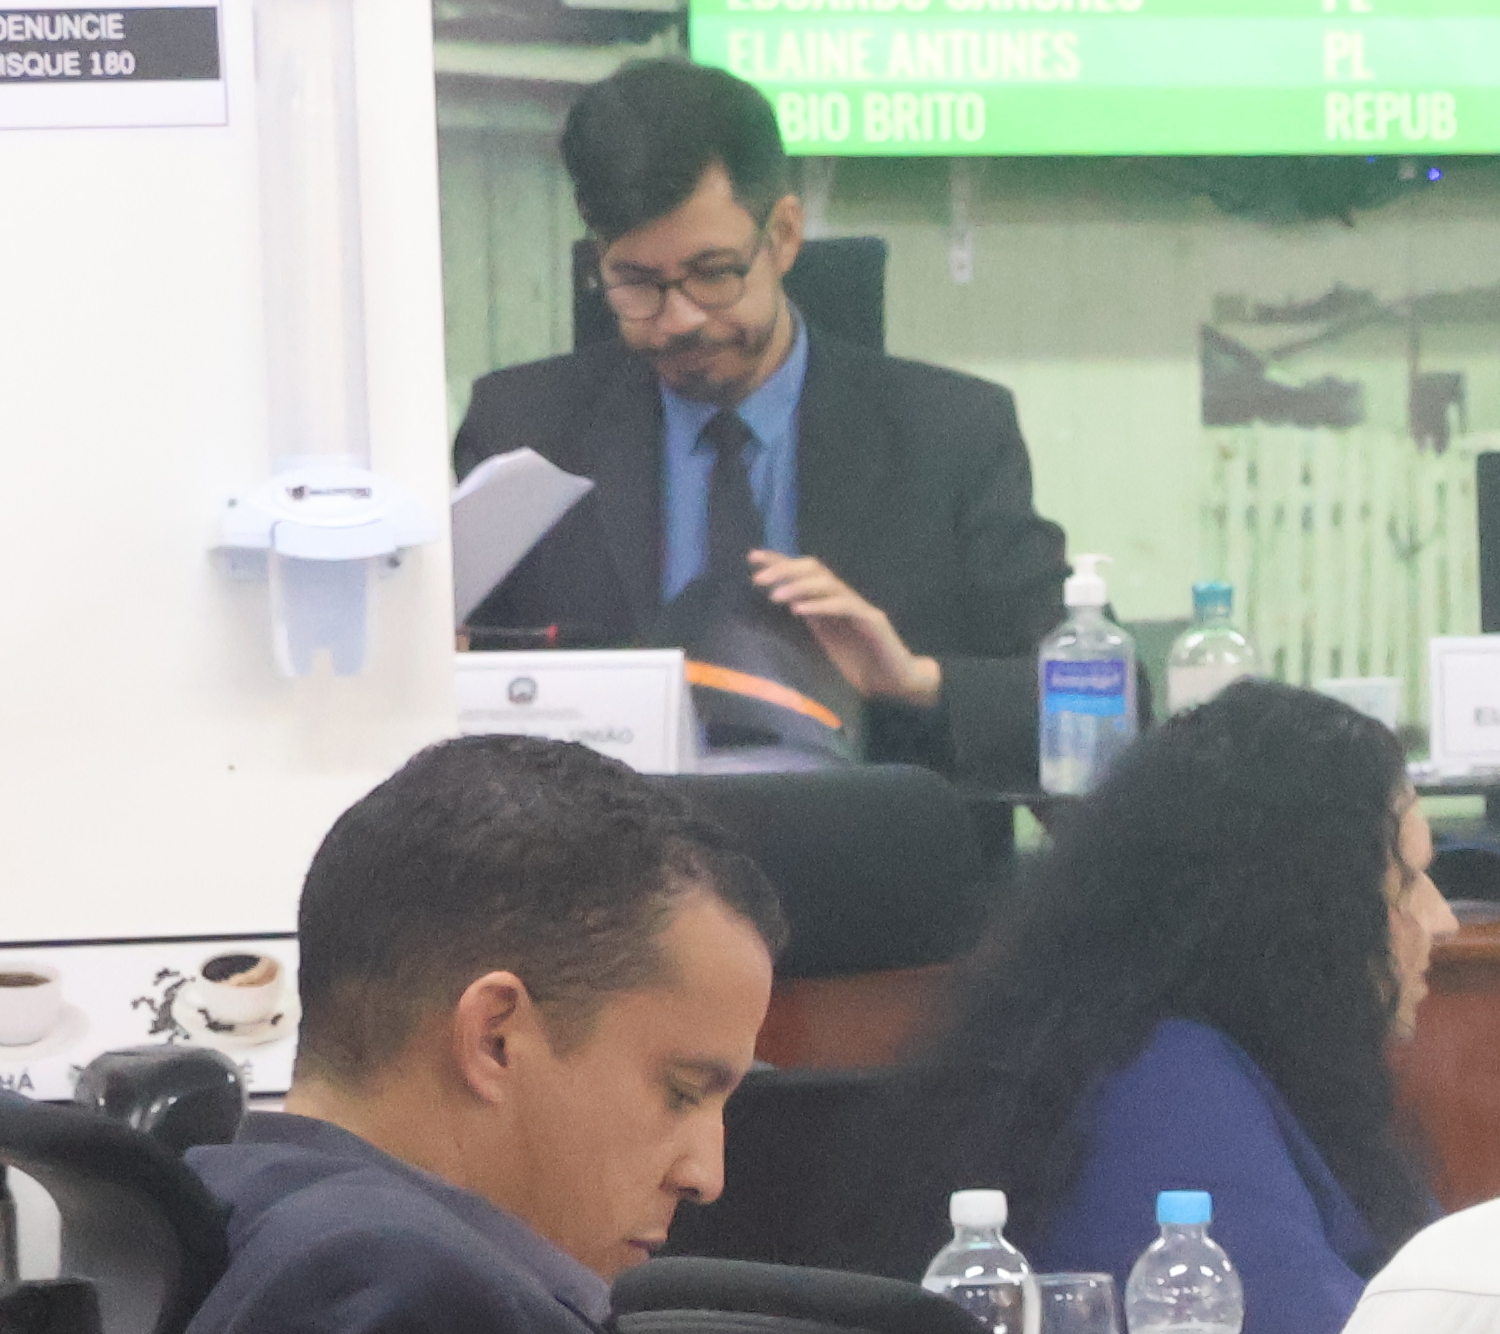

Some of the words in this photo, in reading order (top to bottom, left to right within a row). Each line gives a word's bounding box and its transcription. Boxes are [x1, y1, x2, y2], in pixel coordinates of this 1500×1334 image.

[89, 49, 136, 75] 180
[727, 28, 878, 83] ELAINE
[884, 29, 1083, 83] ANTUNES
[1323, 28, 1376, 82] PL
[777, 91, 851, 142] BIO
[861, 91, 988, 142] BRITO
[1324, 90, 1457, 142] REPUB
